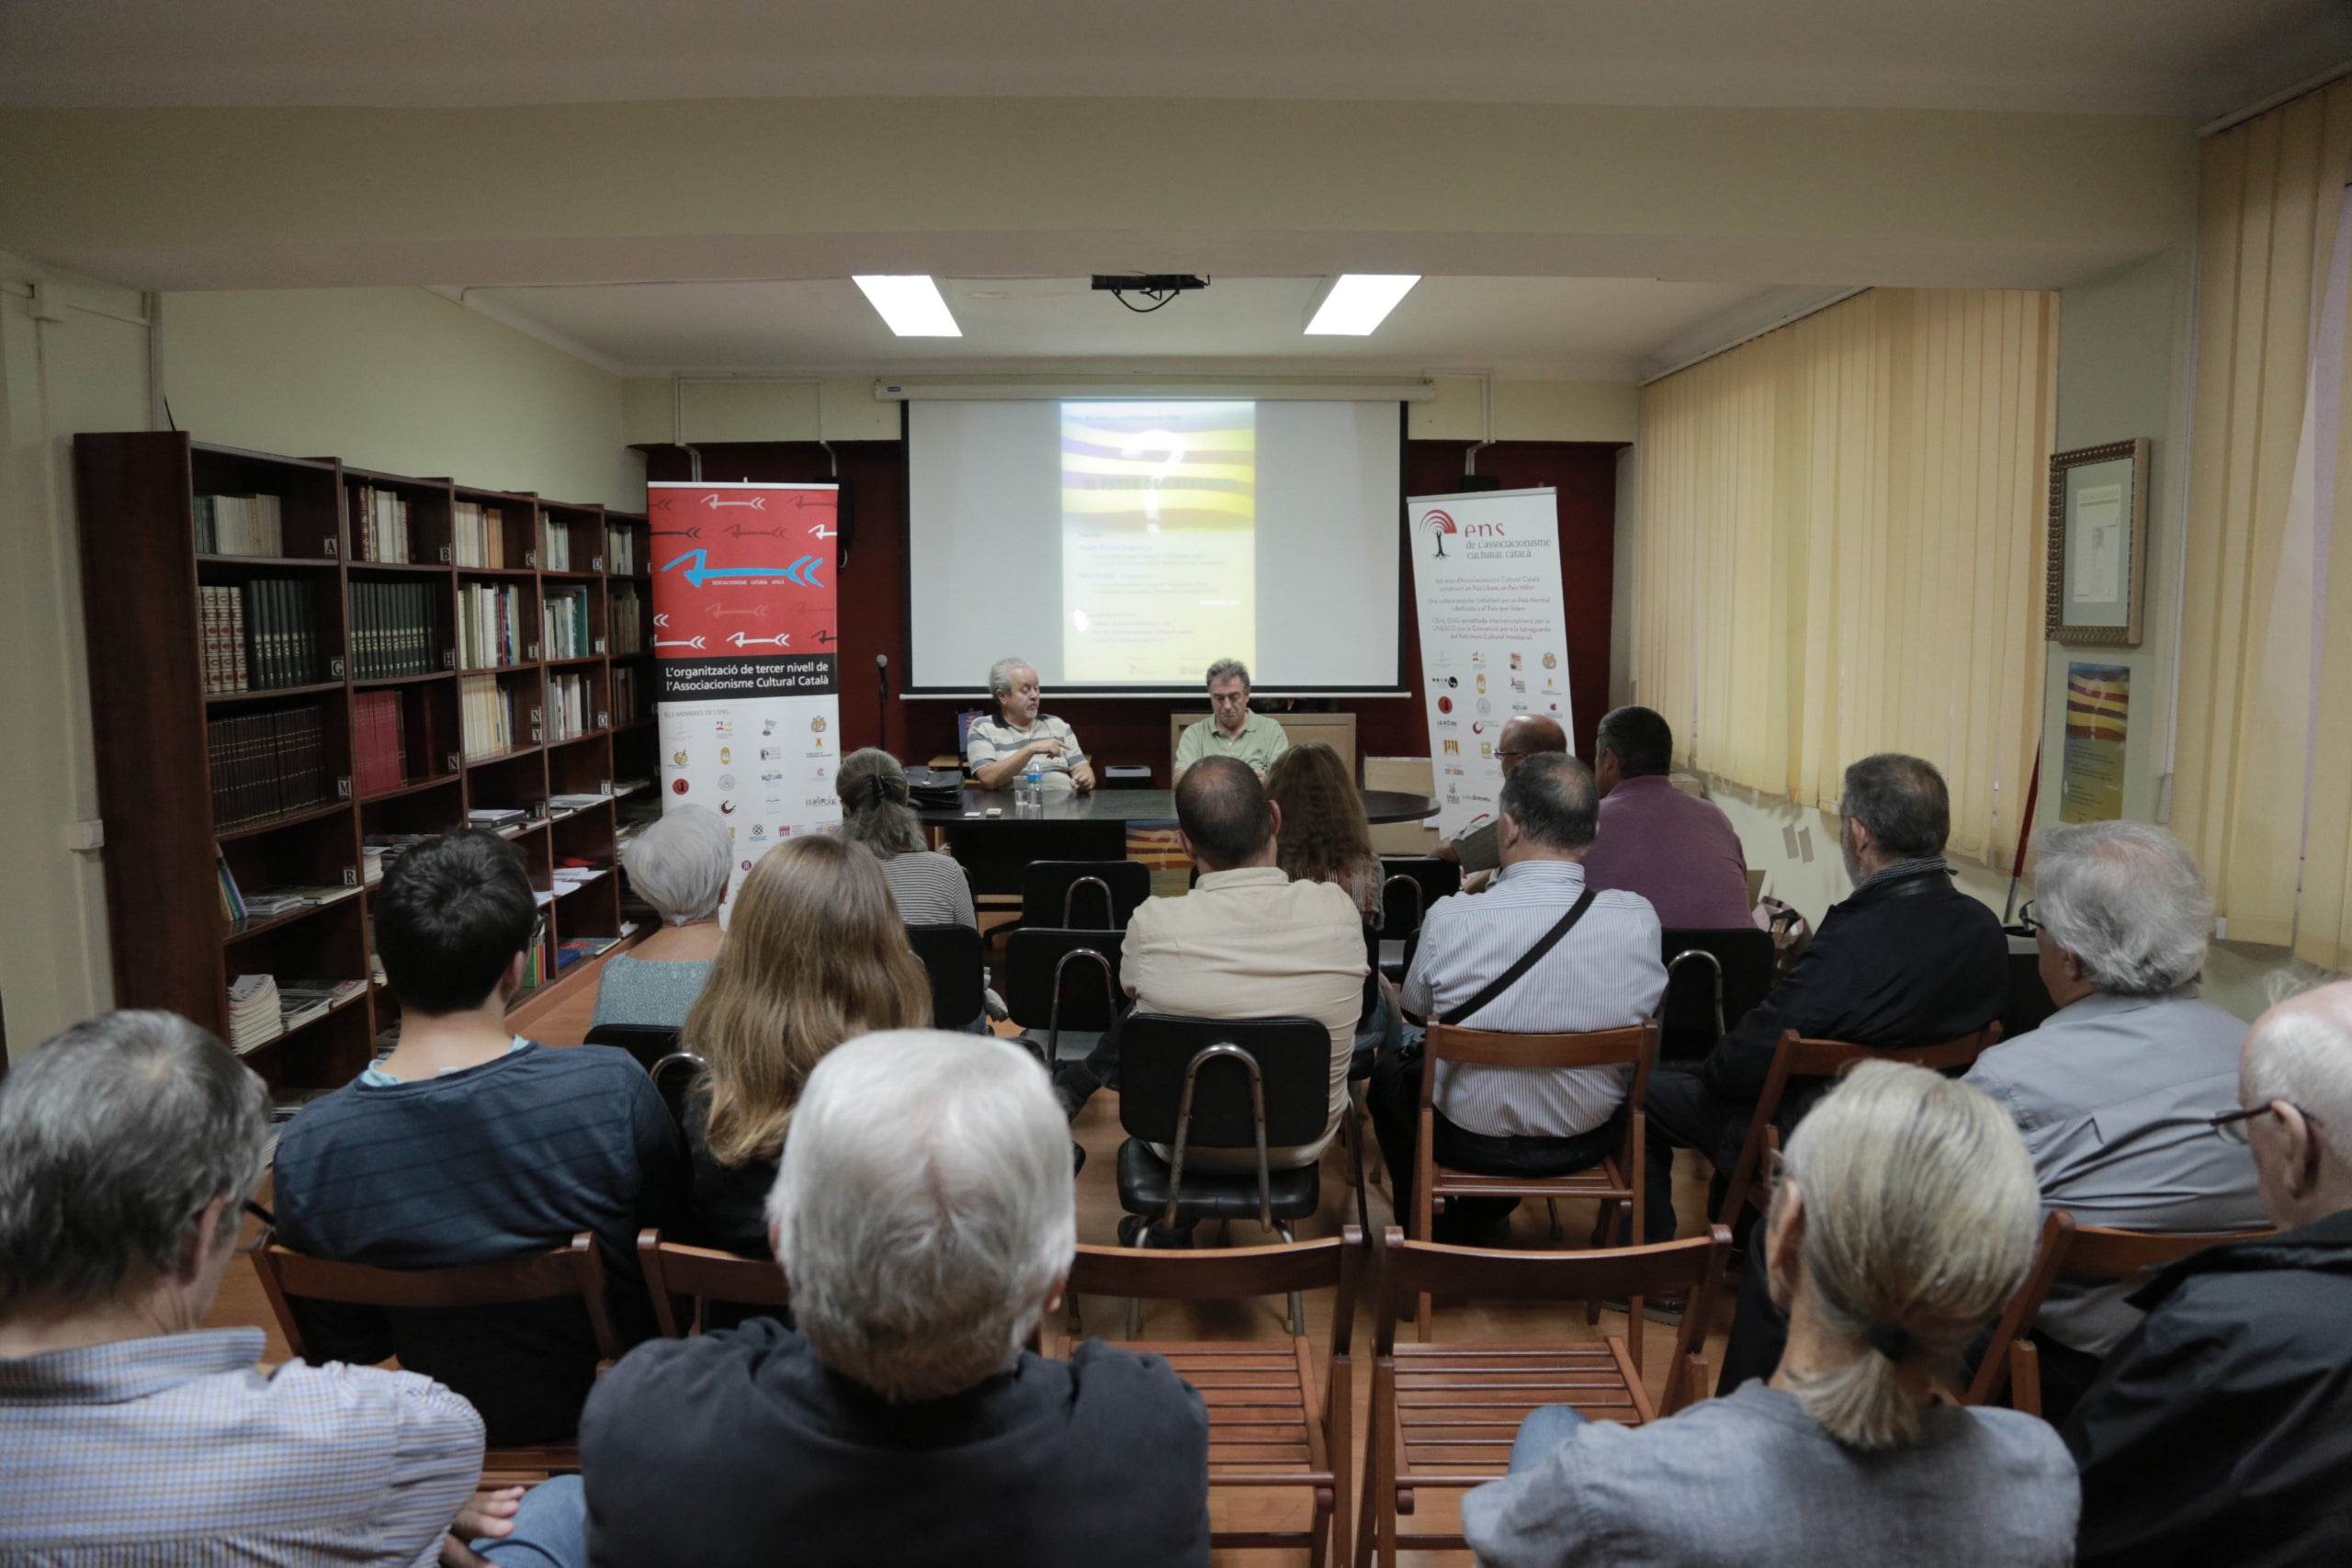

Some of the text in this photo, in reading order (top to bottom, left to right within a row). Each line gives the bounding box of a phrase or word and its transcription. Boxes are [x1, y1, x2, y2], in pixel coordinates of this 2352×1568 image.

[666, 661, 828, 679] L'organització de tercer nivell de
[667, 675, 829, 691] l'Associacionisme Cultural Català
